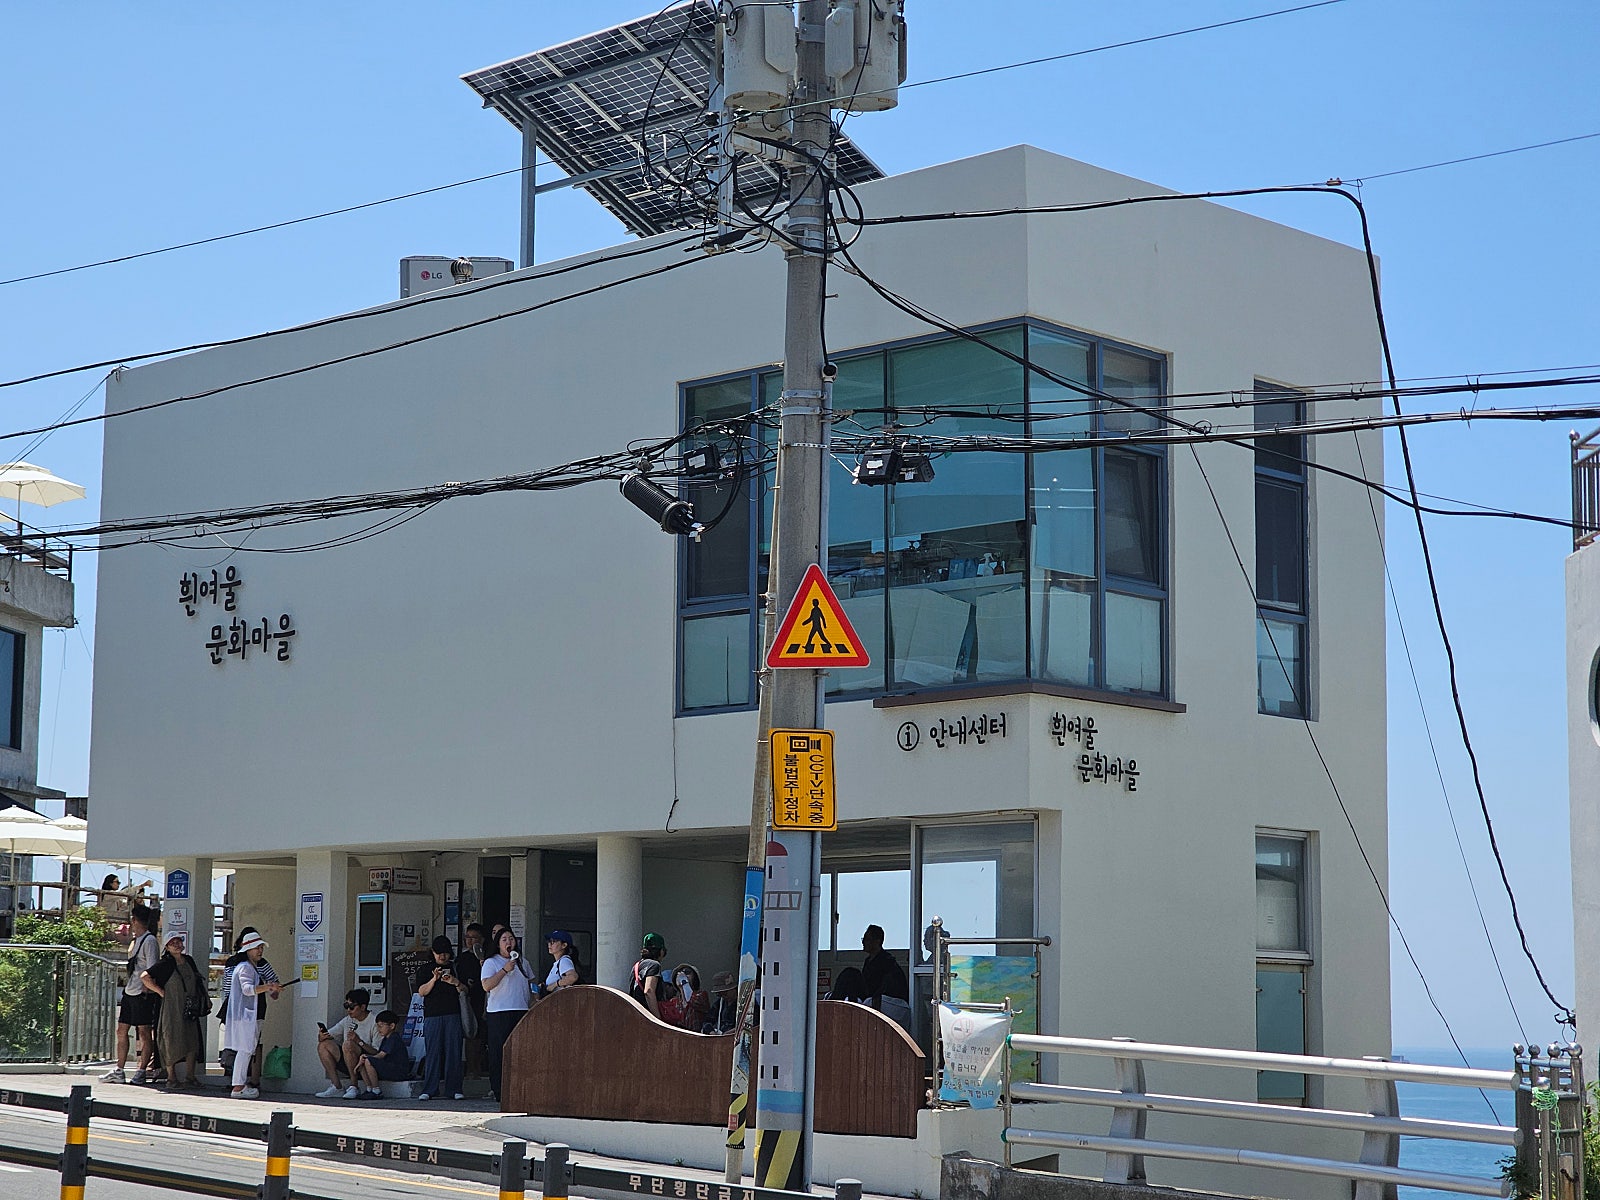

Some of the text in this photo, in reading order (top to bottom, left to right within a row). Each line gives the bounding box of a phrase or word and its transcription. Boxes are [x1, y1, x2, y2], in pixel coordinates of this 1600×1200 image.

[431, 272, 443, 280] LG
[178, 565, 242, 617] 흰여울
[205, 613, 296, 665] 문화마을
[929, 711, 1008, 749] 안내센터
[1051, 711, 1099, 750] 흰여울
[808, 753, 825, 824] CCTV단속중
[1077, 751, 1141, 792] 문화마을
[171, 884, 185, 896] 194
[130, 1107, 217, 1133] 무단횡단금지
[336, 1136, 438, 1165] 무단횡단금지
[629, 1174, 755, 1200] 무단횡단금지
